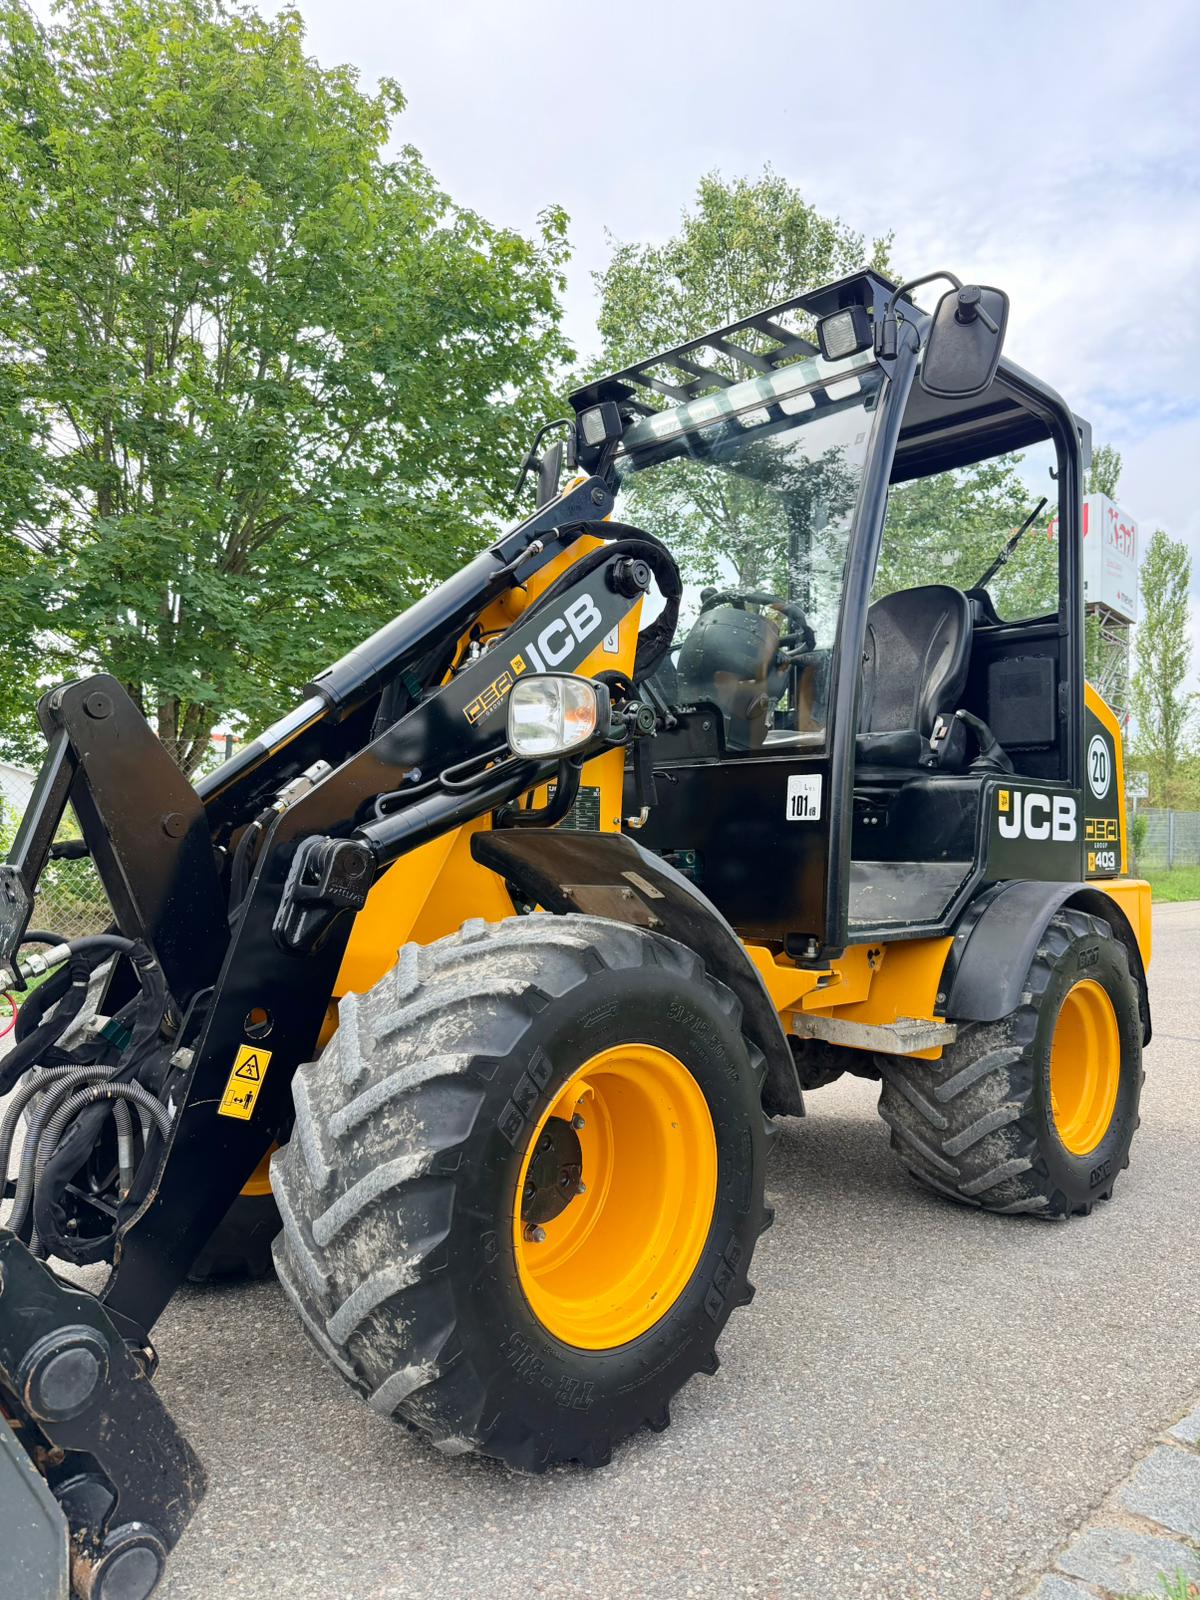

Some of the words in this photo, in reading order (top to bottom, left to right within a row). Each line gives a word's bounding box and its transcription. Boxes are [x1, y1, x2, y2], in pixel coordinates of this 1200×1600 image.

[525, 593, 602, 673] JCB
[1092, 751, 1106, 782] 20
[791, 795, 808, 816] 101
[999, 791, 1077, 841] JCB
[1095, 851, 1115, 868] 403
[498, 1045, 553, 1150] BKT
